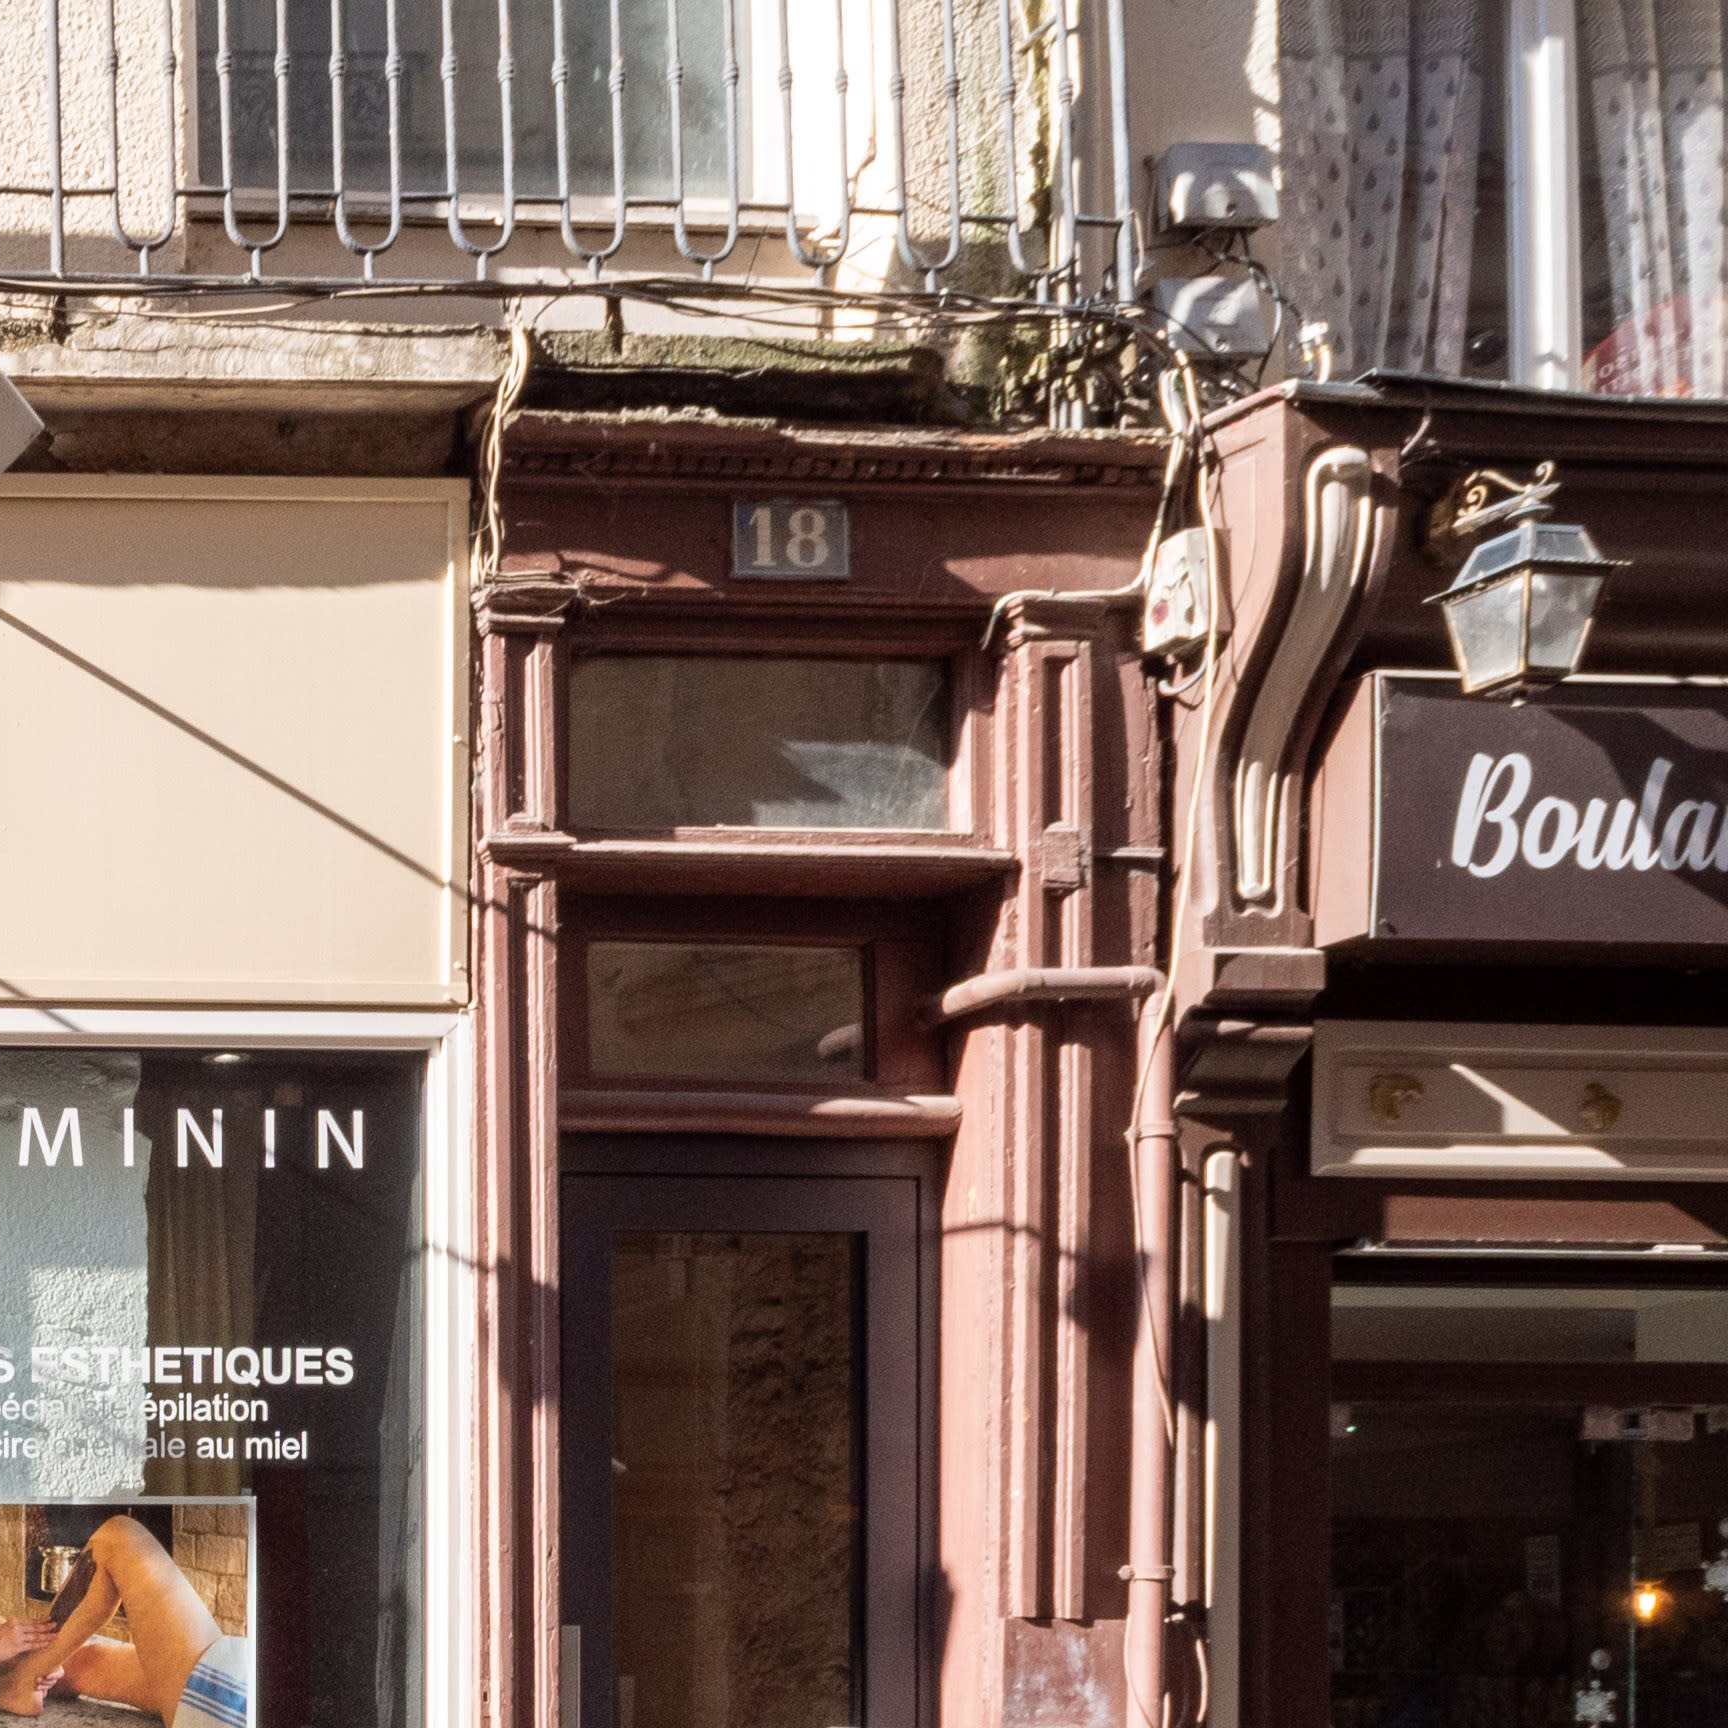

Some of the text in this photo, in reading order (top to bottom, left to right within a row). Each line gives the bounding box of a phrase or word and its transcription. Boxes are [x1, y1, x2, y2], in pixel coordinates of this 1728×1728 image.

[748, 506, 828, 570] 18
[1451, 751, 1728, 878] Boula
[30, 1346, 355, 1388] ESTHETIQUES
[139, 1391, 269, 1428] épilation
[195, 1437, 235, 1460] au
[244, 1430, 308, 1460] miel
